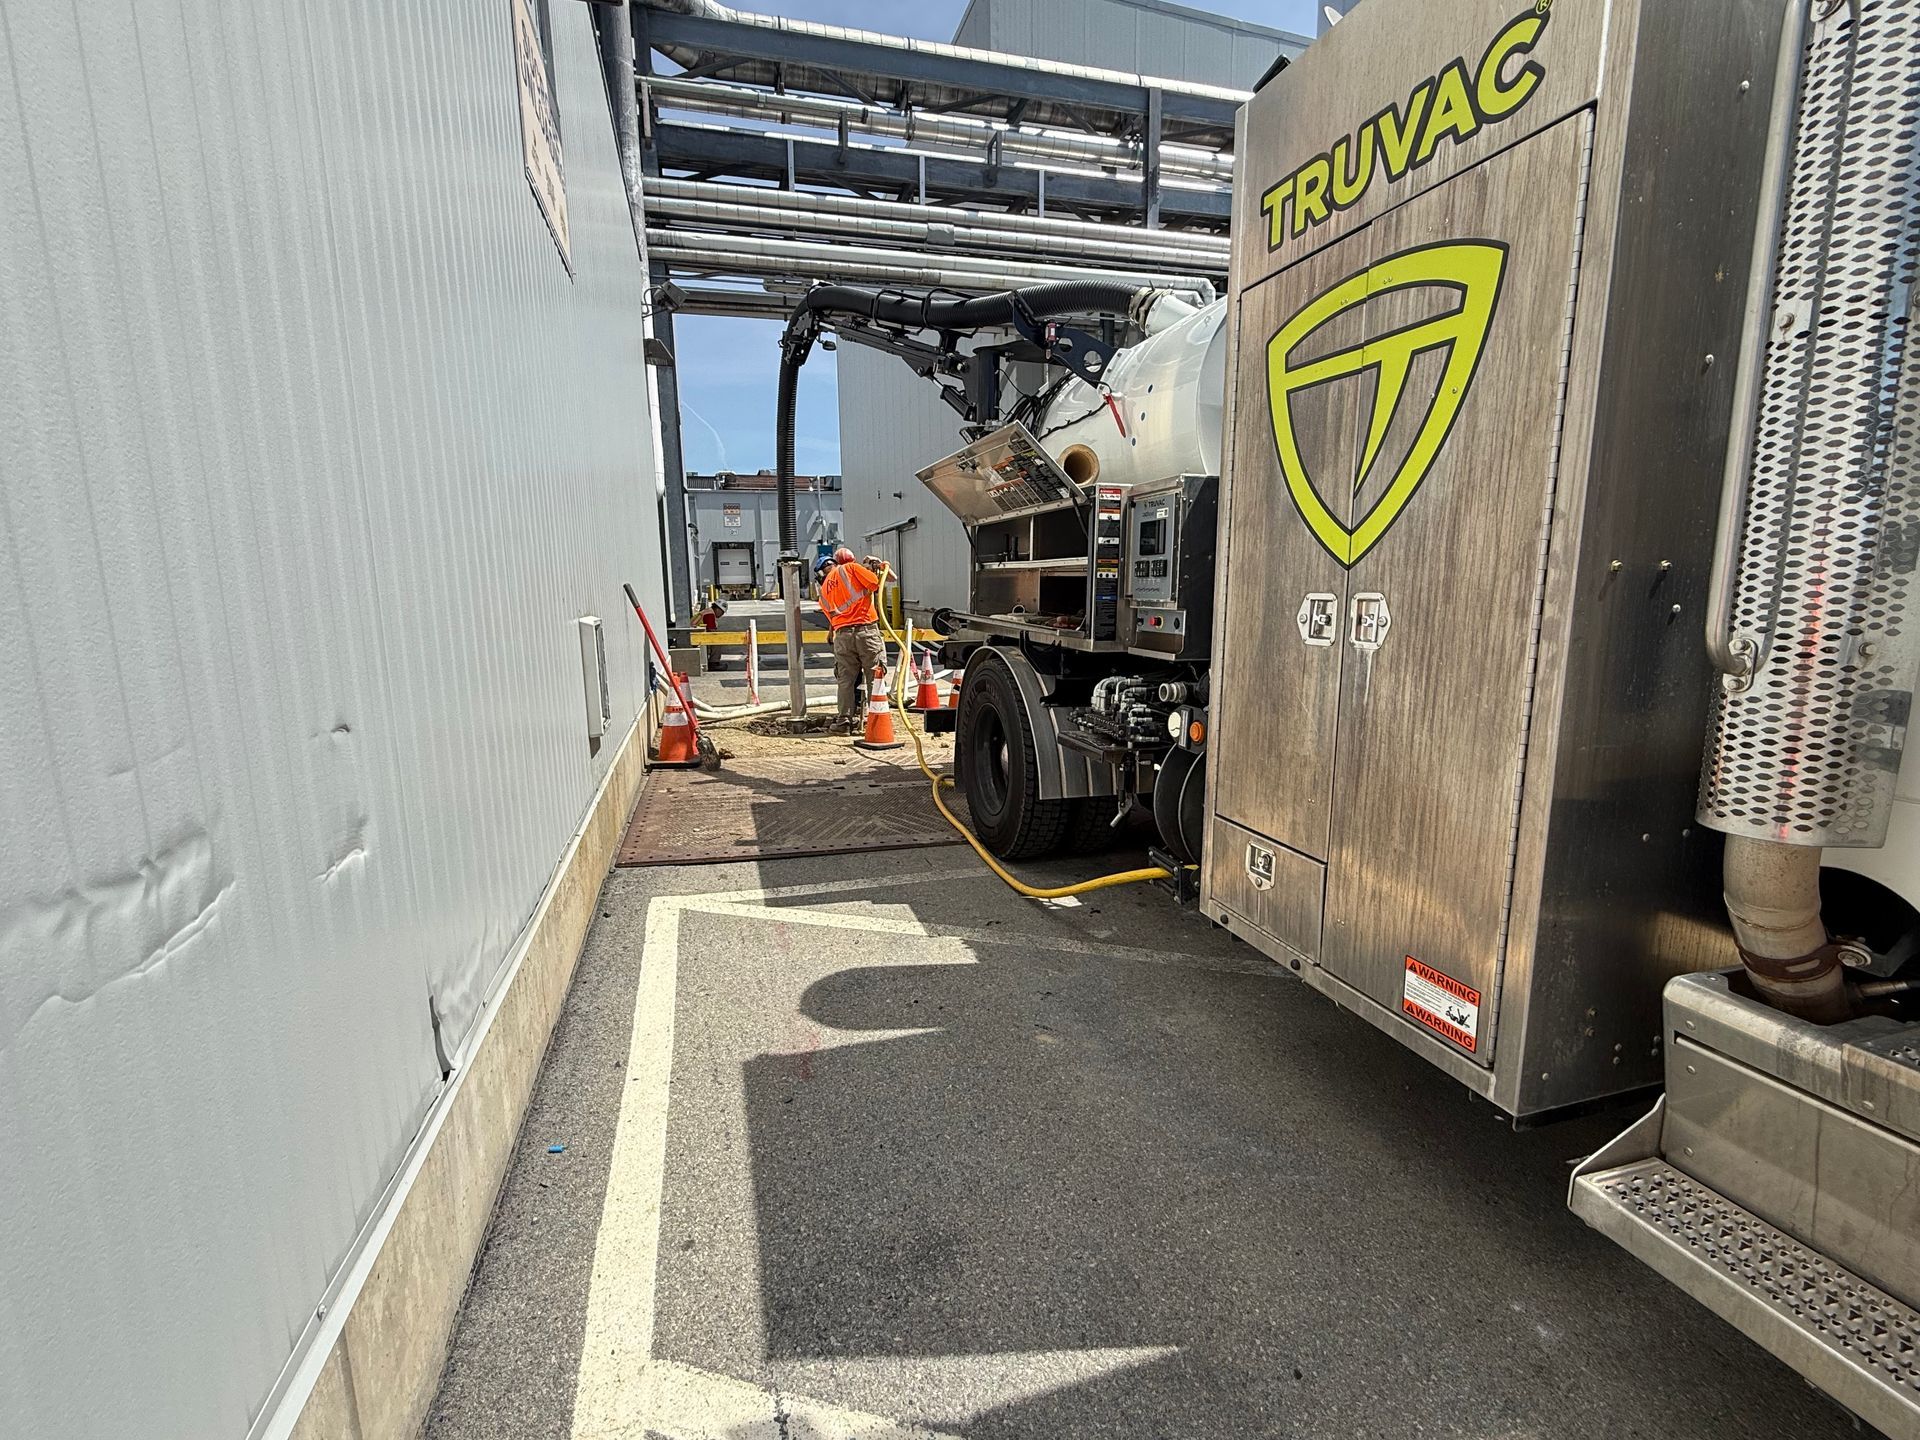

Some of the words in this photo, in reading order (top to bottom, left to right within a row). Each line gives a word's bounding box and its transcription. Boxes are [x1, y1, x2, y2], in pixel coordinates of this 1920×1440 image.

[1261, 11, 1548, 251] TRUVAC
[1418, 964, 1477, 1003] WARNING
[1415, 1010, 1473, 1048] WARNING
